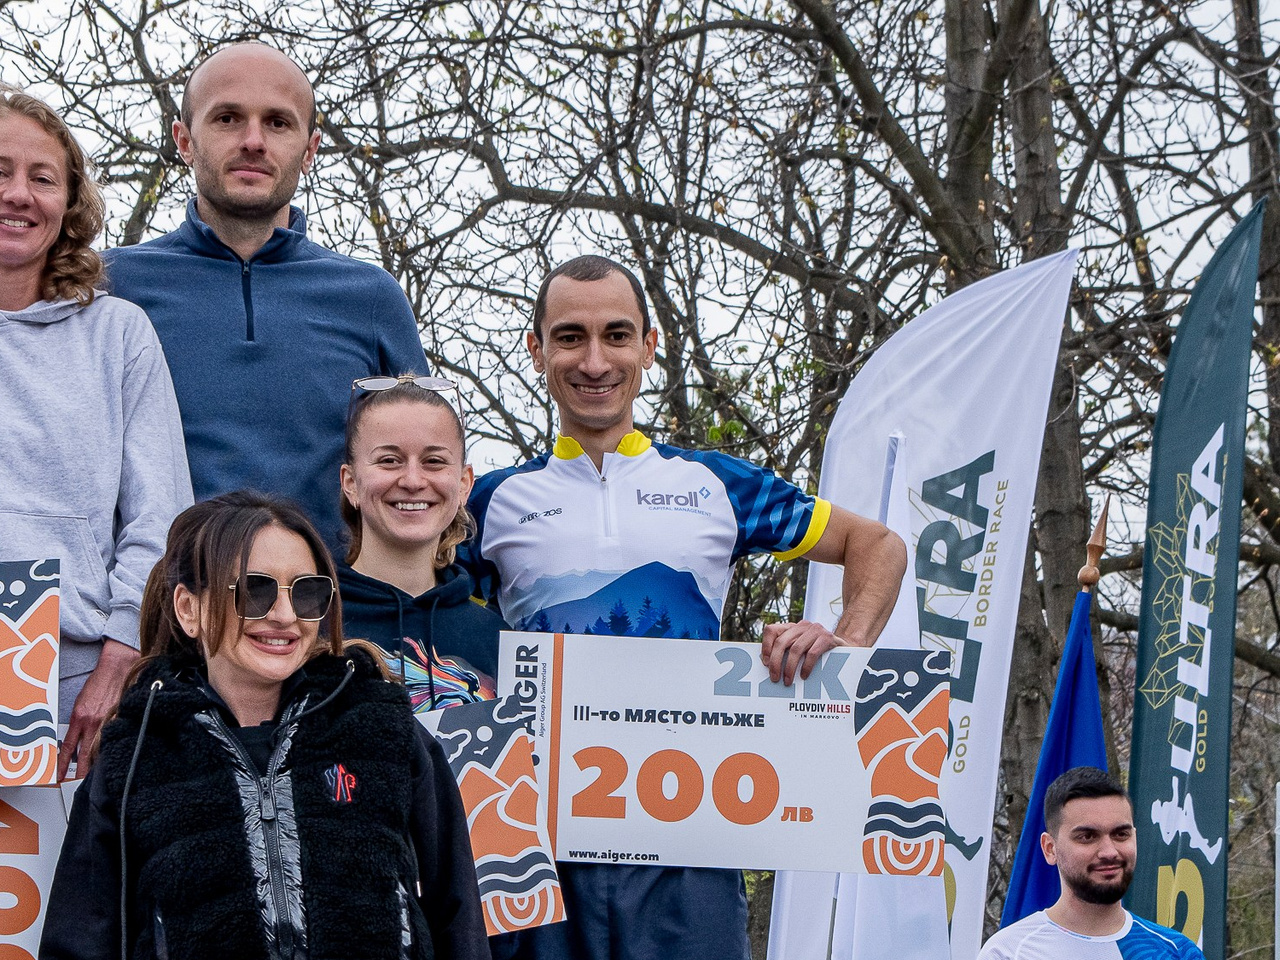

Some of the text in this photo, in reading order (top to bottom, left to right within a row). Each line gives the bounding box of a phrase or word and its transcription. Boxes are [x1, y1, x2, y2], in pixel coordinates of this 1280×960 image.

[637, 489, 699, 508] karoll
[674, 507, 712, 517] MANAGEMENT
[974, 479, 1009, 627] BORDER RACE
[915, 449, 996, 760] LTRA
[1170, 422, 1224, 774] ULTRA
[540, 693, 546, 703] AG
[789, 702, 851, 714] PLOVDIV HILLS
[625, 708, 696, 725] МЯСТО
[701, 711, 765, 728] МЪЖЕ
[953, 715, 971, 773] GOLD
[1196, 709, 1208, 772] GOLD
[571, 746, 814, 825] 200 лв
[568, 848, 660, 863] www.aiger.com
